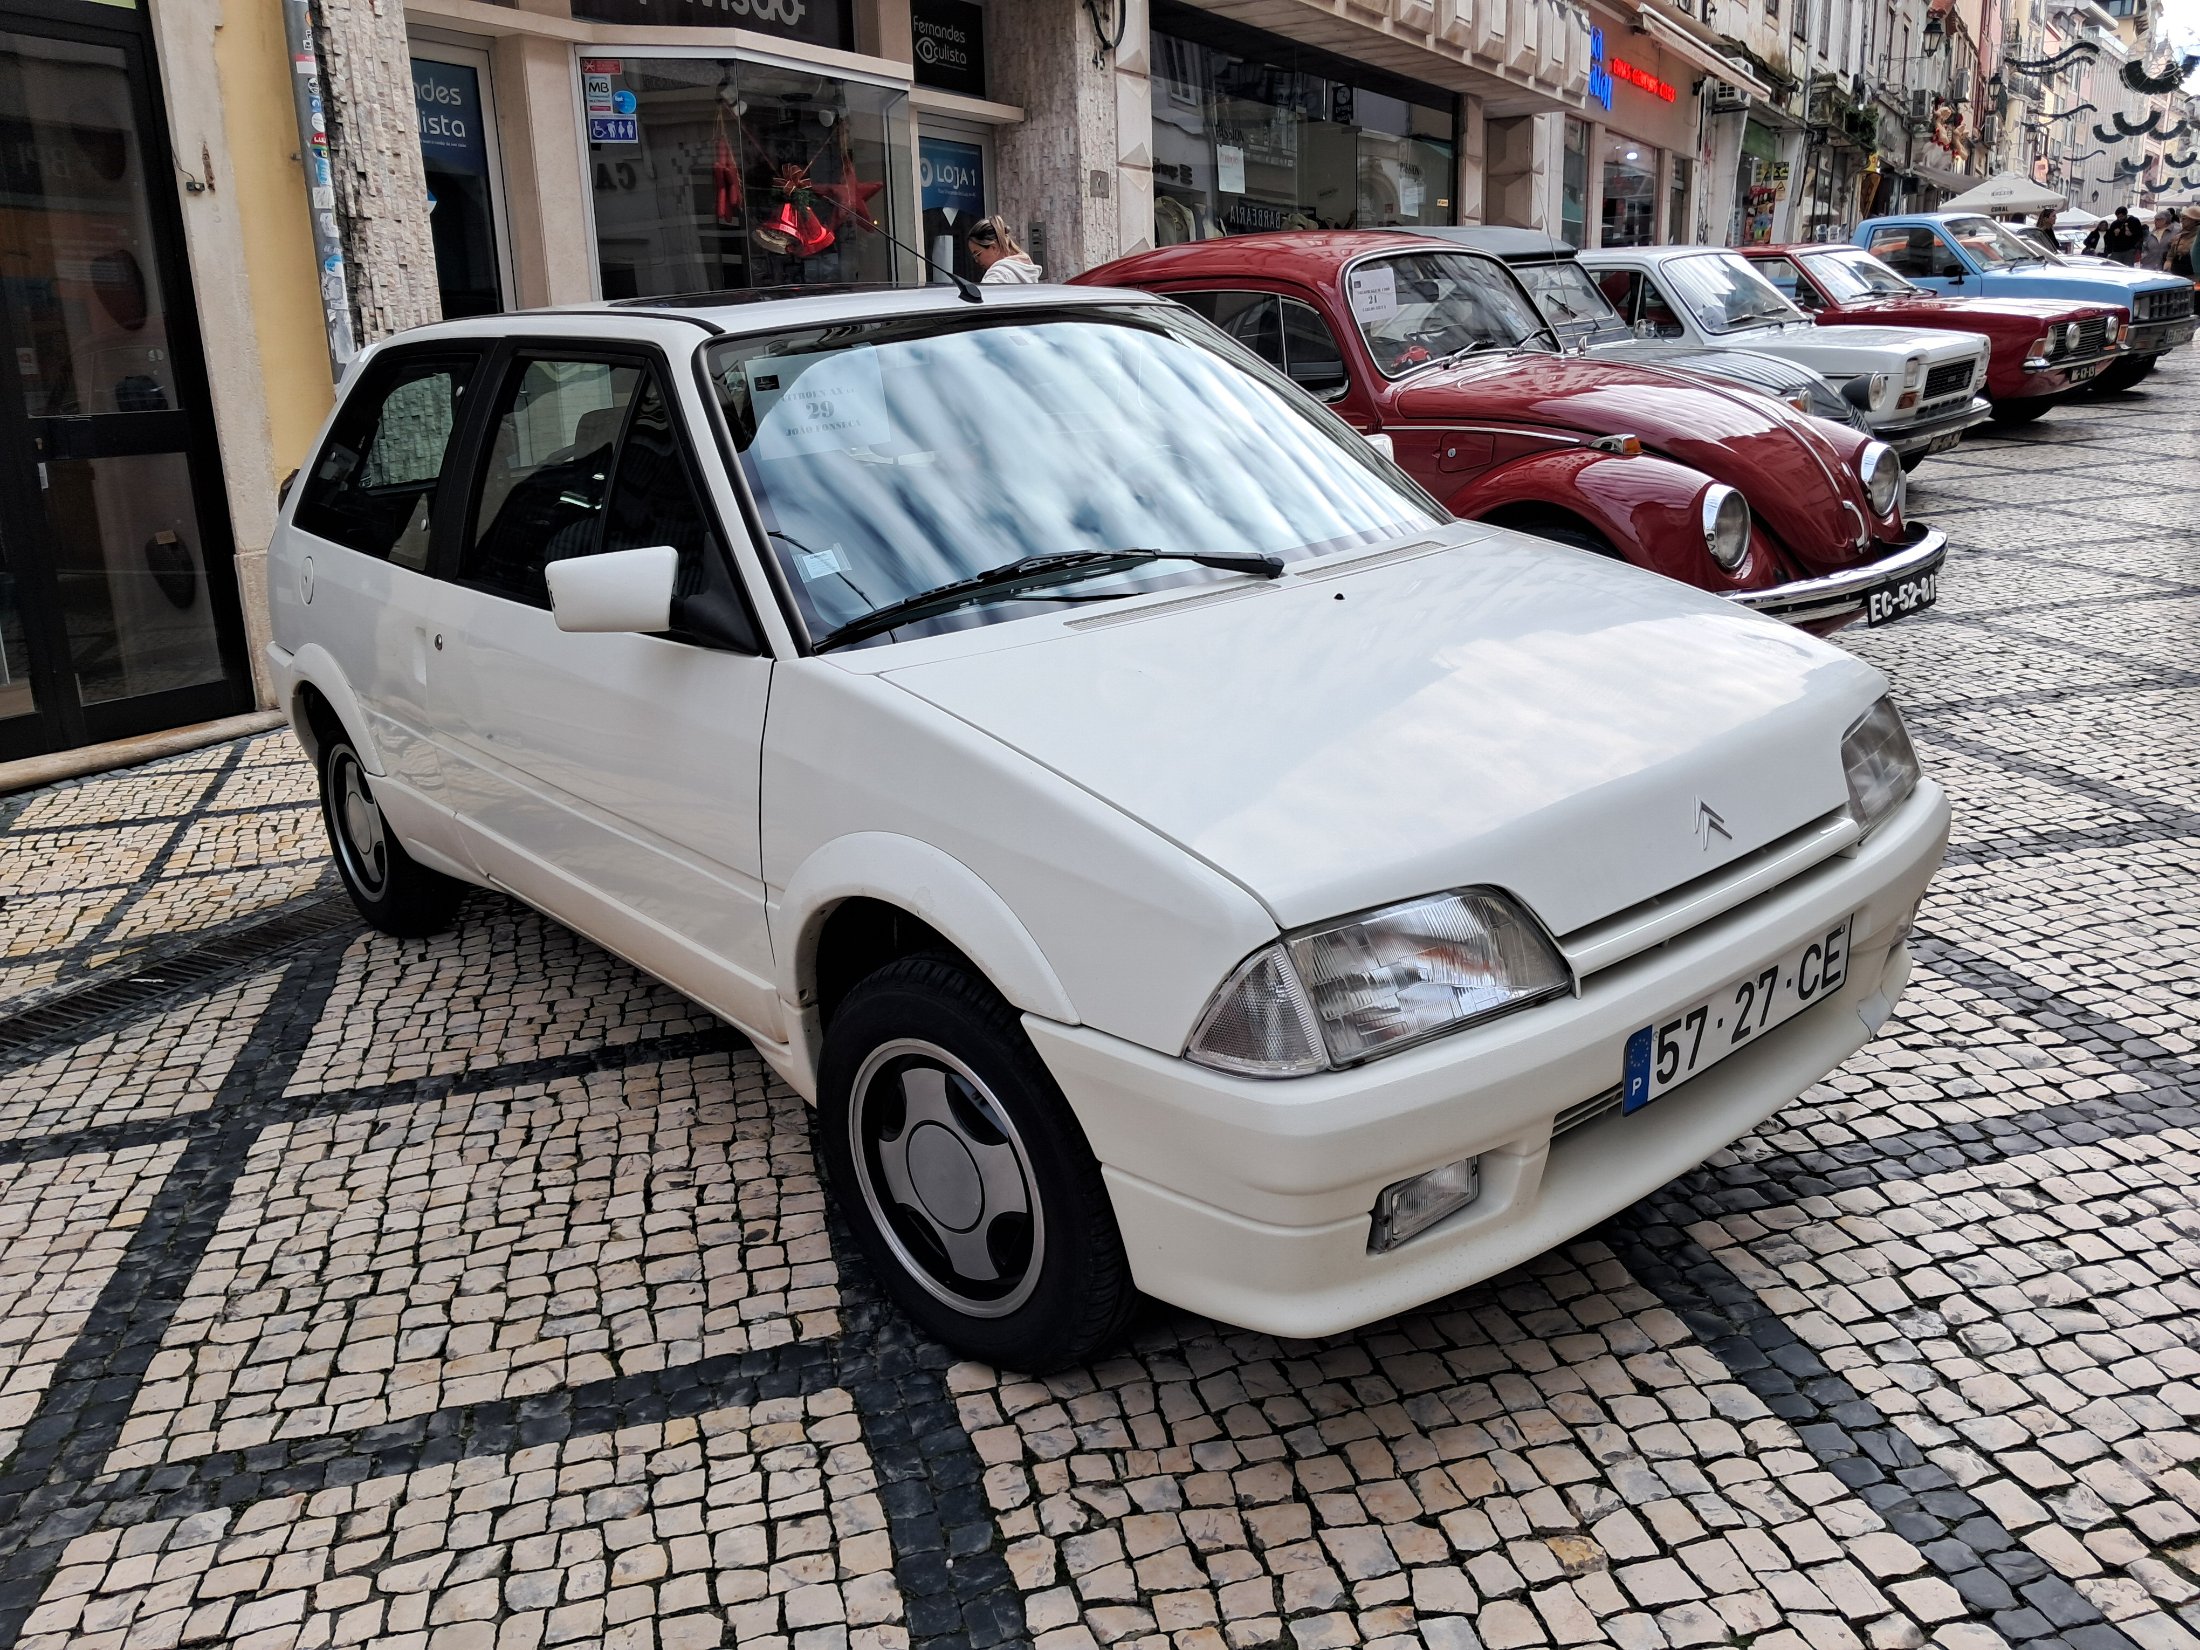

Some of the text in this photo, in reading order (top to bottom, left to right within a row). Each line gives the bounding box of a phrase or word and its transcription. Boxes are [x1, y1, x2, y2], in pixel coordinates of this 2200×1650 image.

[913, 15, 966, 44] Fernandes
[916, 37, 967, 65] Oculista
[588, 82, 610, 93] MB
[937, 163, 976, 189] LOJA 1
[806, 401, 834, 419] 29
[1632, 1077, 1642, 1096] P
